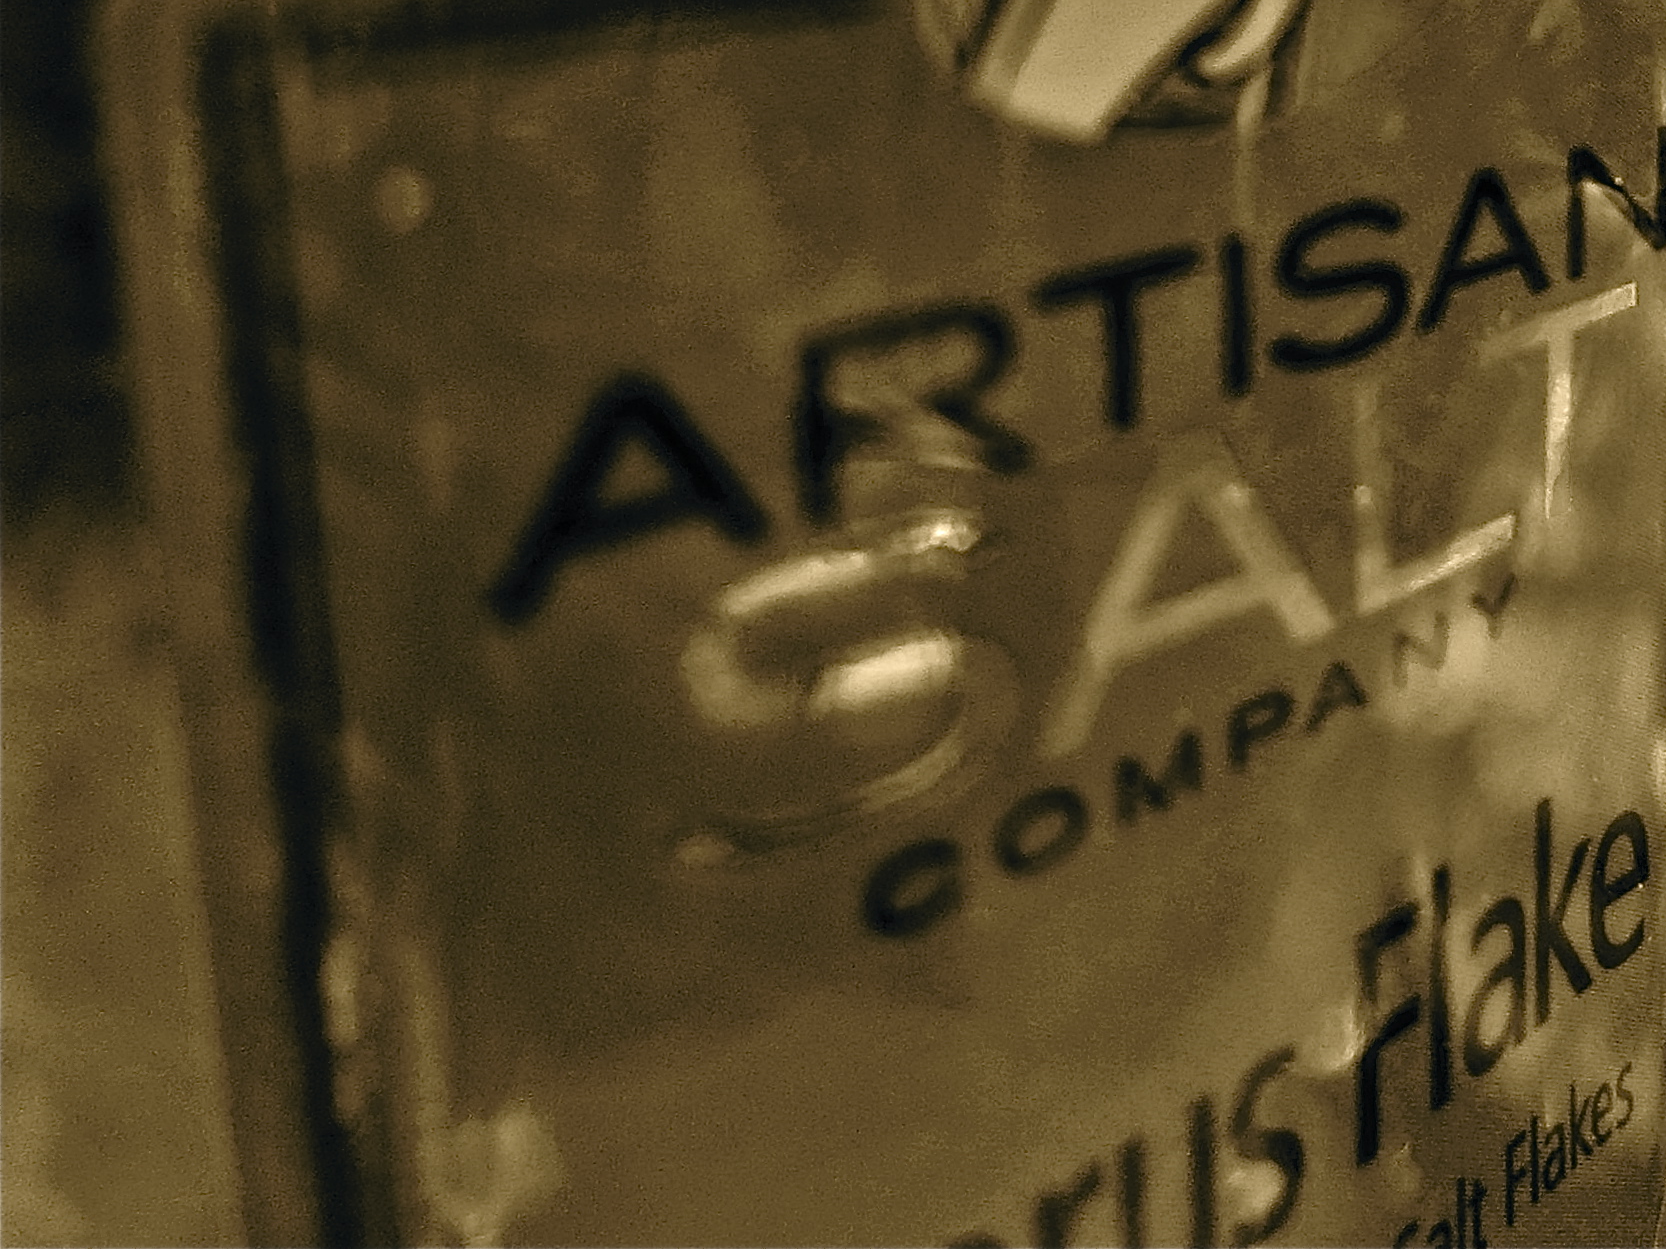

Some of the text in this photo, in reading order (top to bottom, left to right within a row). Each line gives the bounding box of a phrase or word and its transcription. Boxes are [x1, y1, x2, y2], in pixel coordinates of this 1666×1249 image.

[676, 279, 1639, 869] SALT
[857, 571, 1520, 939] COMPANY
[1352, 796, 1652, 1167] Flake
[1503, 1060, 1636, 1228] Flakes
